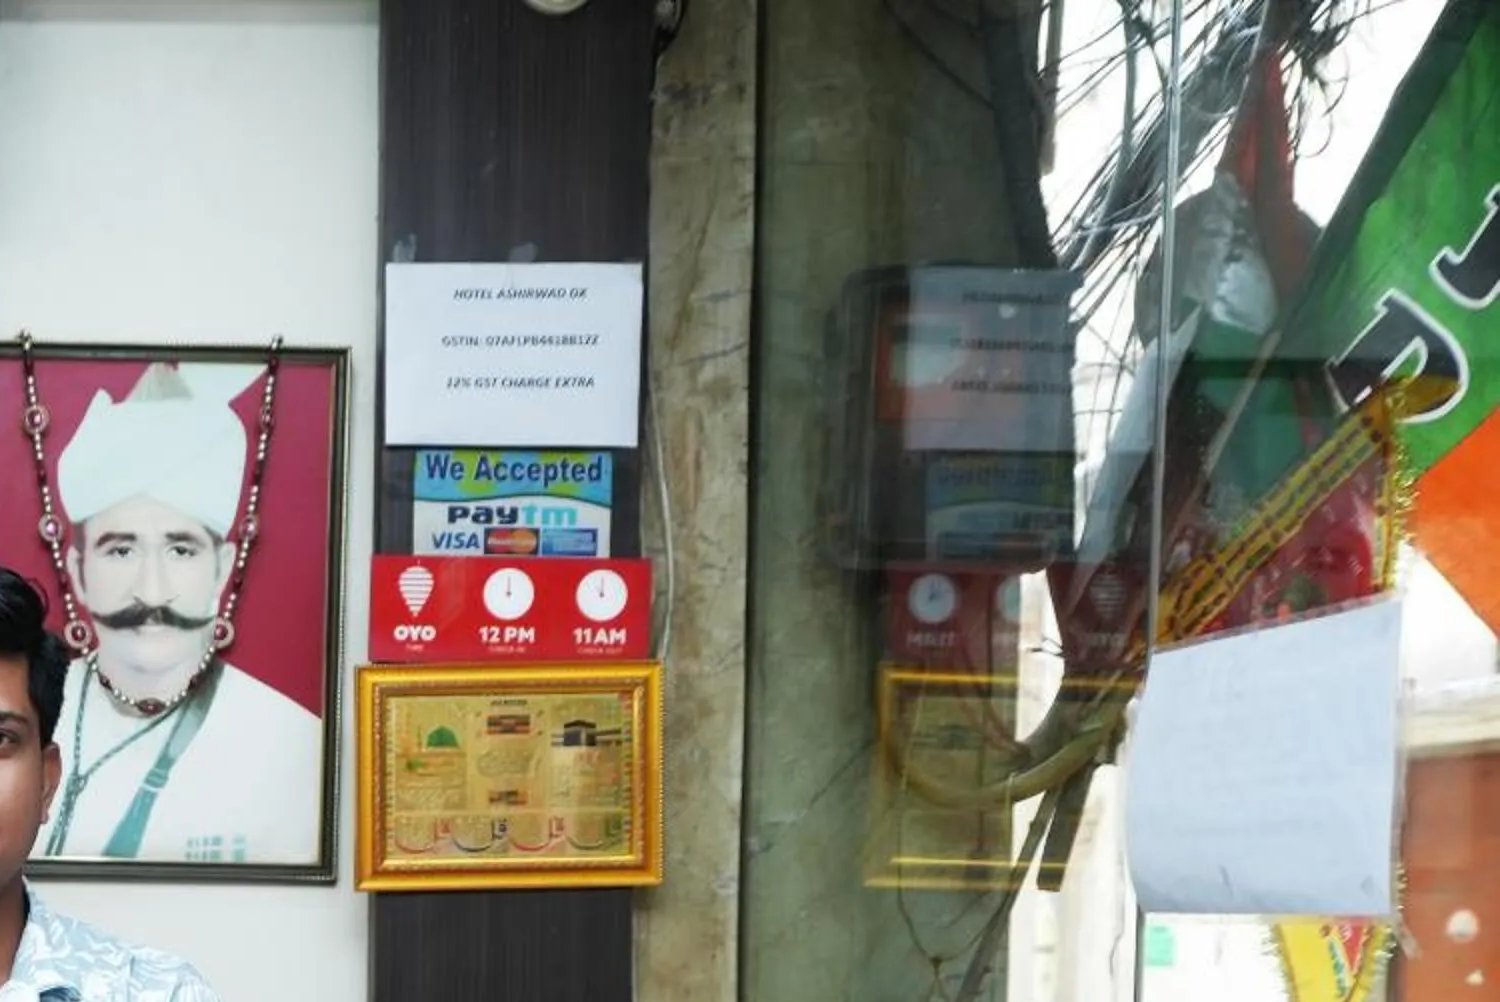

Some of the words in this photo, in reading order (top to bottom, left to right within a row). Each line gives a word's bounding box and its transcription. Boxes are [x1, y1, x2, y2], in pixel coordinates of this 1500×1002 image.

[474, 376, 498, 388] GST
[501, 376, 550, 388] CHARGE
[554, 376, 595, 388] EXTRA
[426, 454, 464, 480] We
[474, 453, 603, 488] Accepted
[432, 532, 481, 549] VISA
[394, 625, 437, 641] OYO
[478, 627, 500, 643] 12
[503, 627, 535, 643] PM
